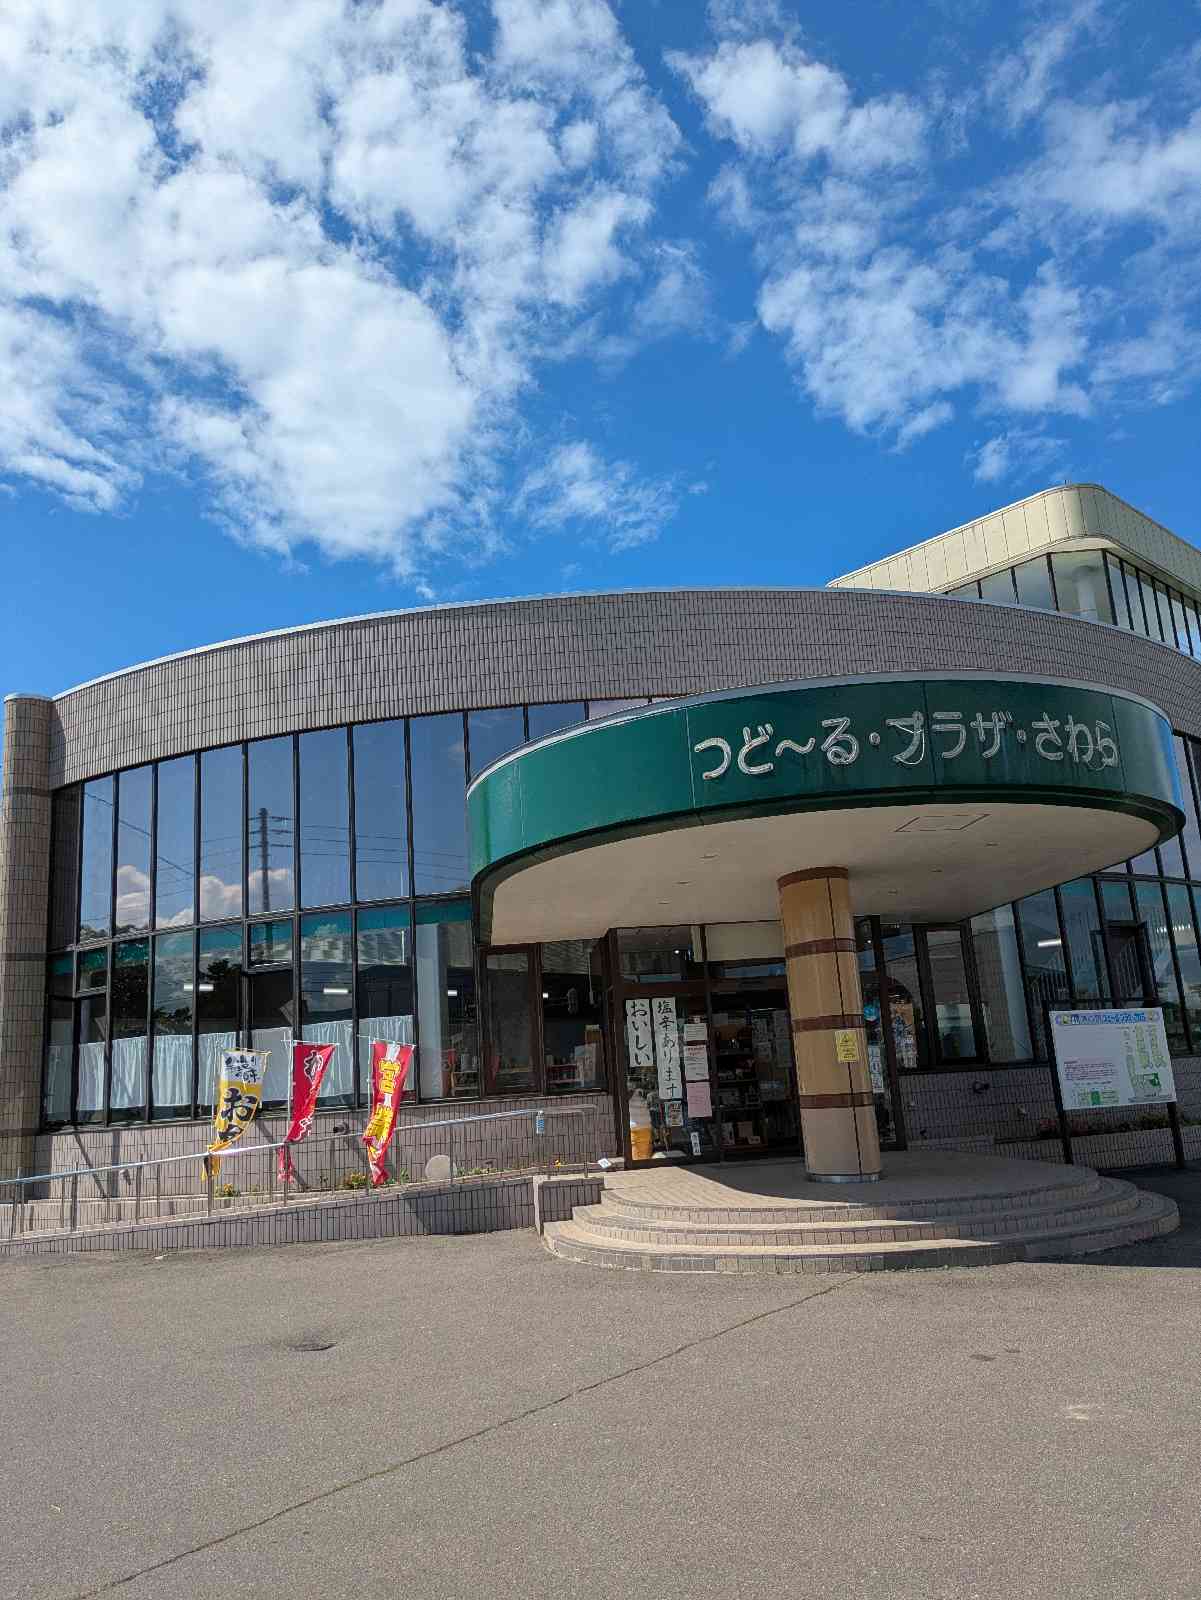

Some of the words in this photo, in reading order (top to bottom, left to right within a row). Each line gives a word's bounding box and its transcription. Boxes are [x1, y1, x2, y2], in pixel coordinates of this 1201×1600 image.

[630, 1000, 650, 1066] おいしい
[657, 1000, 679, 1096] 塩辛あります
